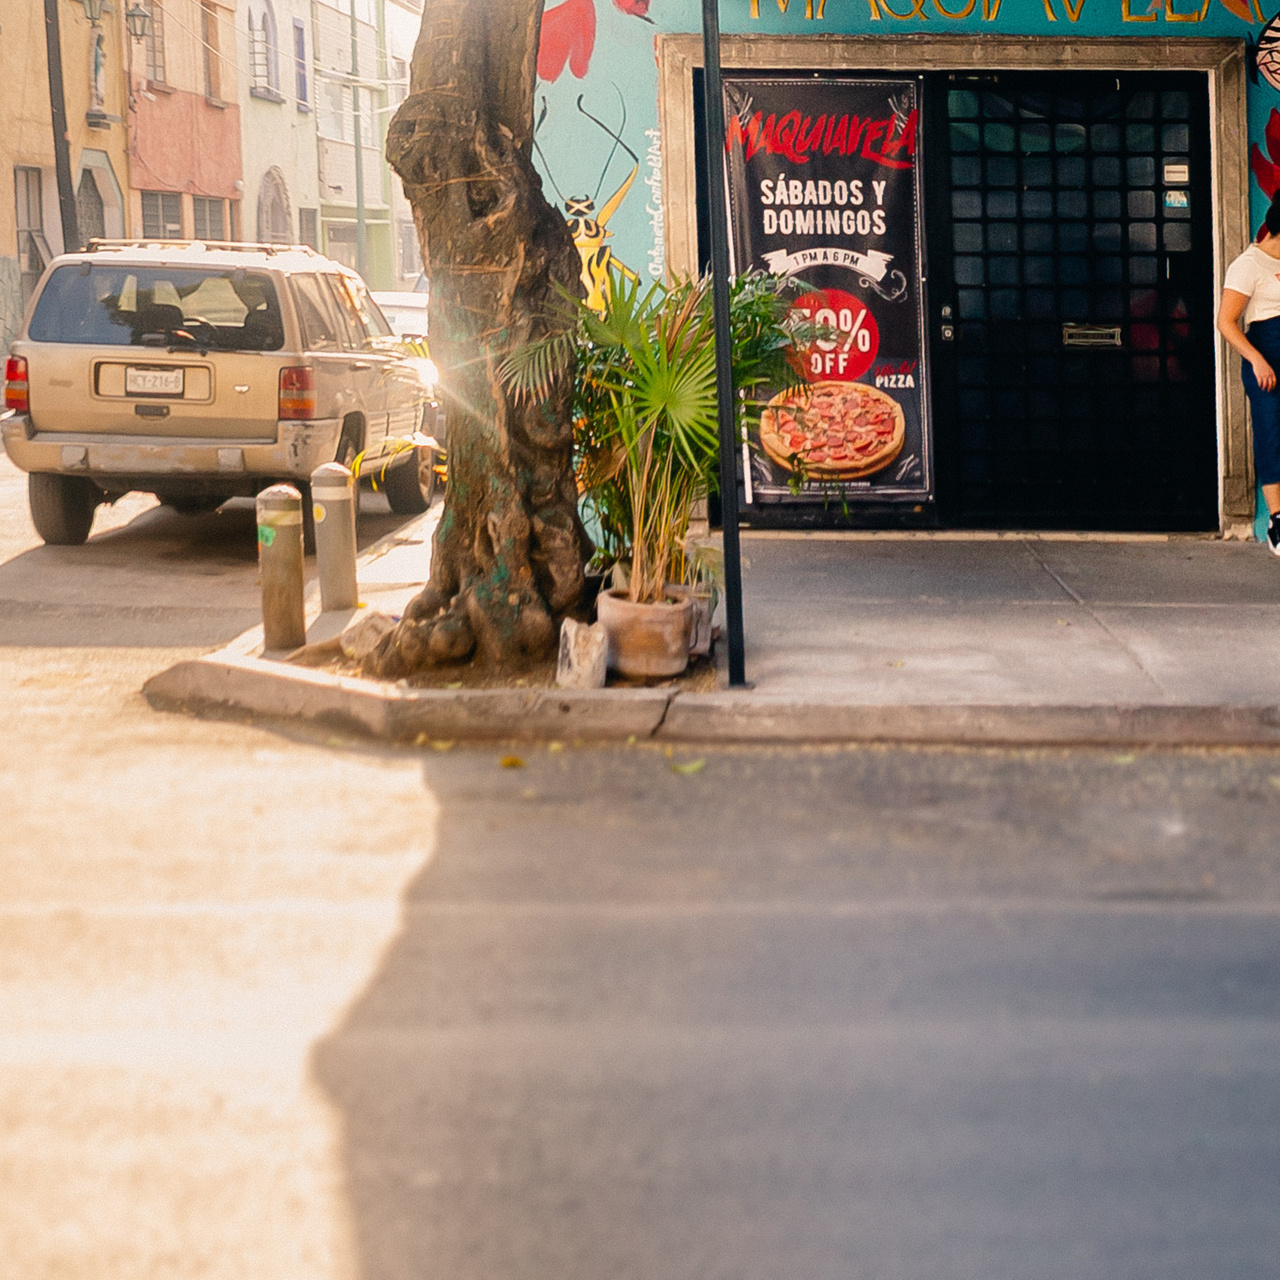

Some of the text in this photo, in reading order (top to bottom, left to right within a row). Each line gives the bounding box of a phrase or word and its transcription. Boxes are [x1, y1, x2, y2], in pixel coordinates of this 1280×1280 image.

[725, 109, 918, 169] MAQUIAVELA
[760, 173, 886, 206] SÁBADOS Y
[763, 209, 887, 235] DOMINGOS
[793, 250, 860, 266] 1 PM A 6 PM
[811, 353, 849, 374] OFF
[875, 374, 915, 388] PIZZA
